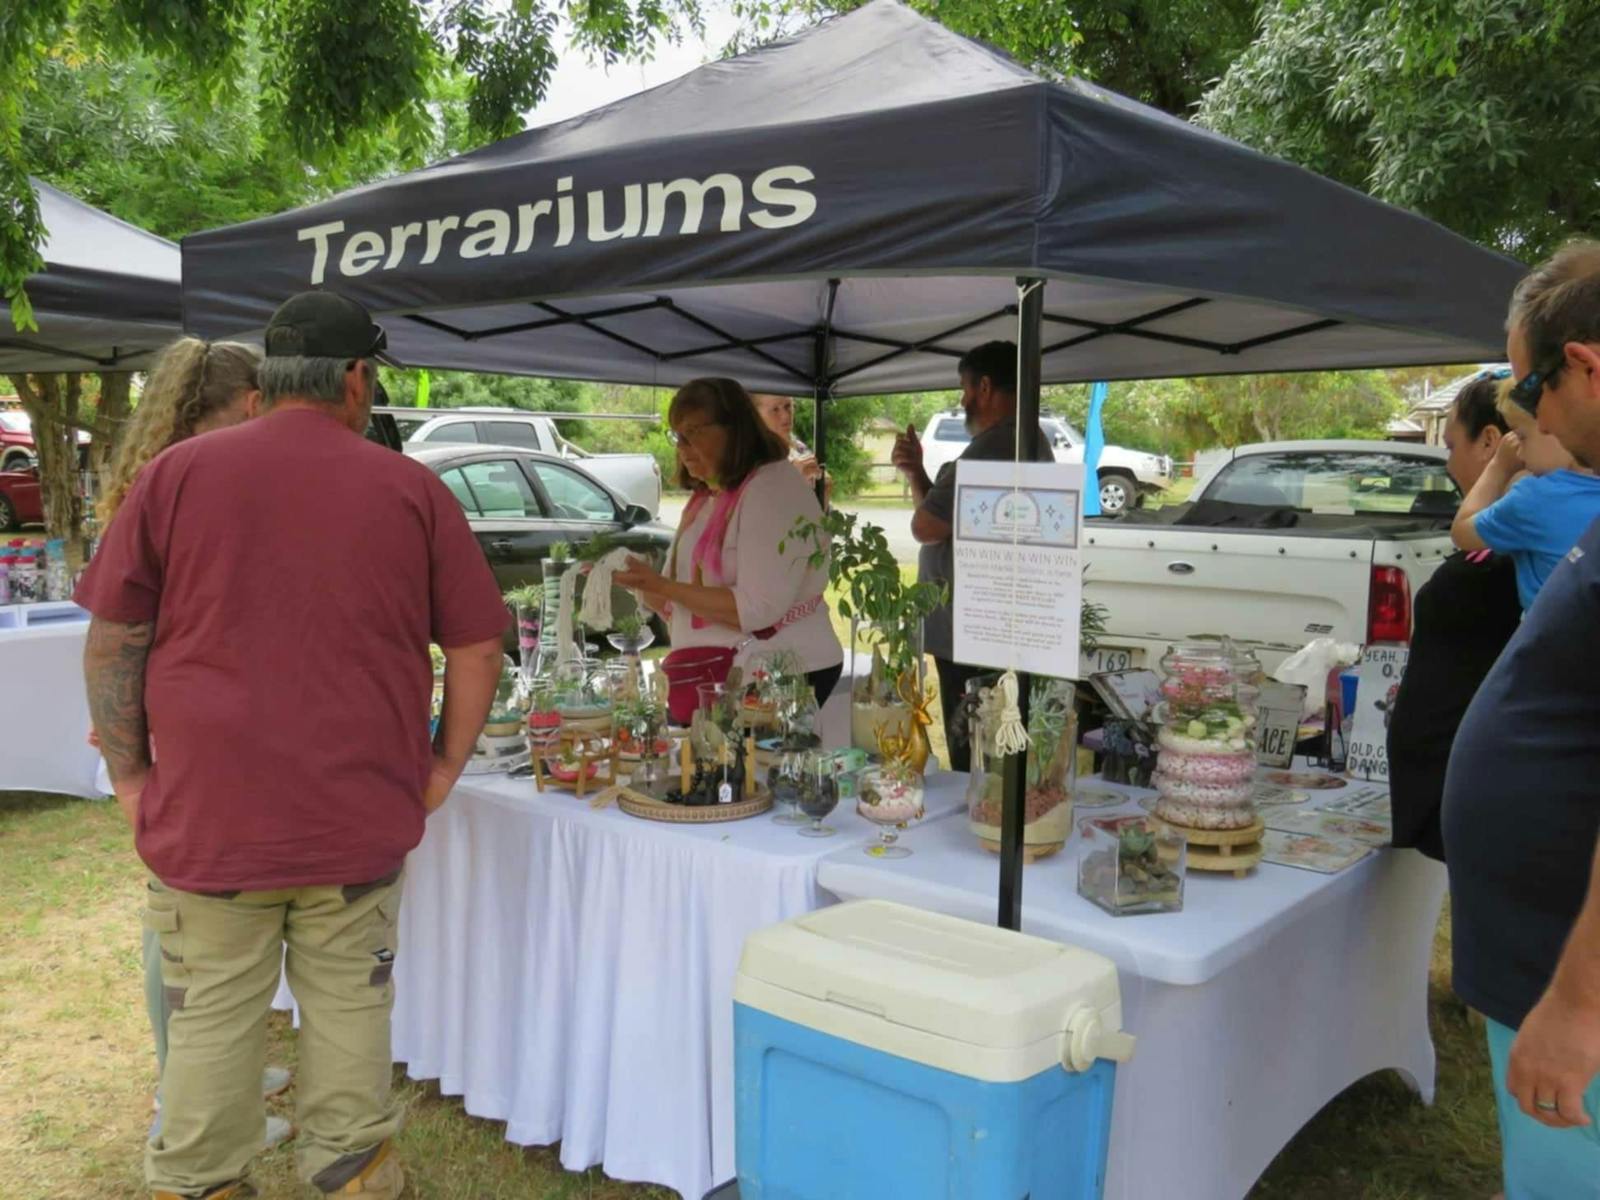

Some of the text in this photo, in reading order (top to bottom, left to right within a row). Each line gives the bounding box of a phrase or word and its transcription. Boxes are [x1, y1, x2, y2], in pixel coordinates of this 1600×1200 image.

[297, 165, 817, 285] Terrariums
[979, 547, 1001, 561] WIN
[1003, 549, 1025, 562] WN
[1027, 551, 1051, 565] WIN
[1053, 553, 1077, 567] WIN
[1098, 651, 1127, 672] 169
